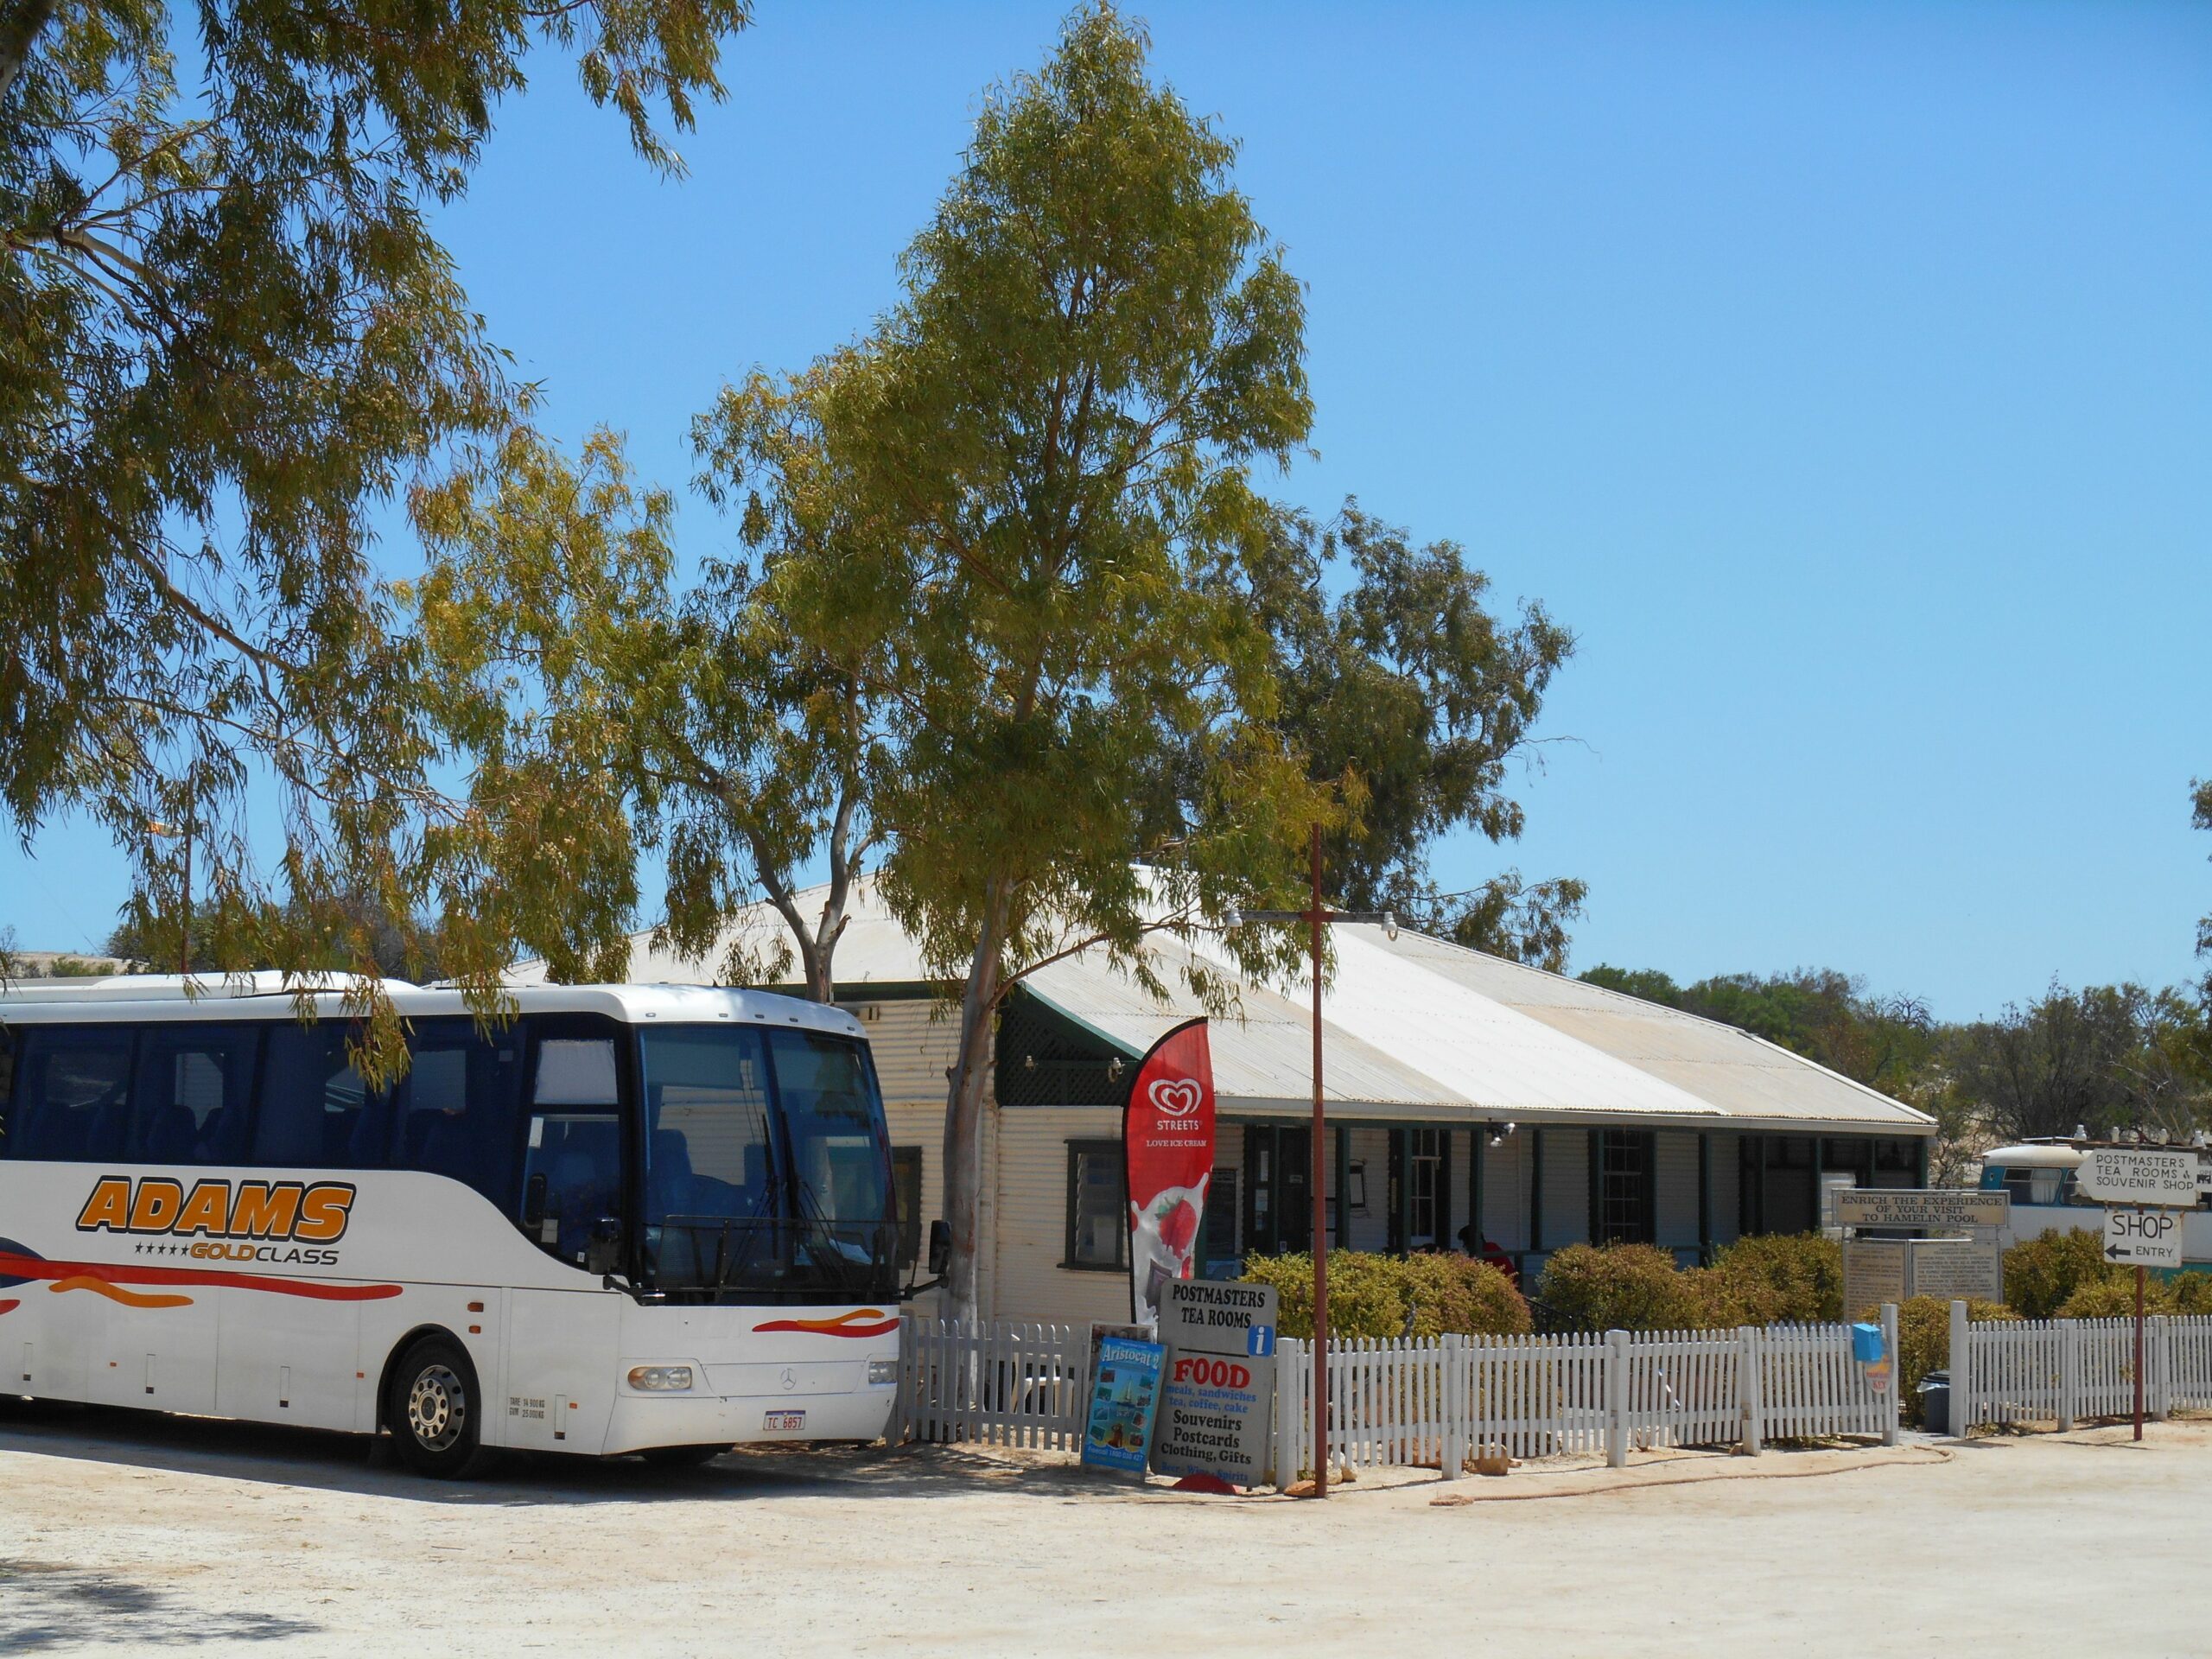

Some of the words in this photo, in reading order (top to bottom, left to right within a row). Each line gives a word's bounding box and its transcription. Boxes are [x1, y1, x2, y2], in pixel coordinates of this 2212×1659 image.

[1157, 1120, 1199, 1130] STREETS
[2095, 1154, 2185, 1168] POSTMASTERS
[2096, 1166, 2121, 1176] TEA
[2133, 1167, 2177, 1179] ROOMS
[2096, 1176, 2156, 1189] SOUVENIR
[2164, 1179, 2194, 1191] SHOP
[76, 1175, 357, 1244] ADAMS
[1841, 1196, 1887, 1205] ENRICH
[1892, 1197, 1918, 1205] THE
[1923, 1197, 2003, 1206] EXPERIENCE
[1897, 1205, 1929, 1214] YOUR
[1862, 1213, 1878, 1222] TO
[1884, 1214, 1941, 1223] HAMELIN
[1947, 1215, 1979, 1224] POOL
[2112, 1215, 2174, 1240] SHOP
[2135, 1245, 2174, 1258] ENTRY
[1172, 1284, 1266, 1308] POSTMASTERS
[1181, 1307, 1205, 1325] TEA
[1208, 1309, 1252, 1329] ROOMS
[1102, 1344, 1151, 1366] Aristocat
[1152, 1354, 1160, 1370] 2
[1173, 1357, 1251, 1389] FOOD
[1166, 1384, 1195, 1397] meals,
[1198, 1388, 1257, 1402] sandwiches
[1169, 1396, 1186, 1408] tea,
[1189, 1399, 1221, 1411] coffee,
[1224, 1402, 1249, 1414] cake
[768, 1417, 778, 1428] TC
[783, 1417, 803, 1428] 6857
[1173, 1409, 1242, 1431] Souvenirs
[1173, 1427, 1240, 1448] Postcards
[1160, 1442, 1217, 1463] Clothing,
[1219, 1450, 1252, 1465] Gifts
